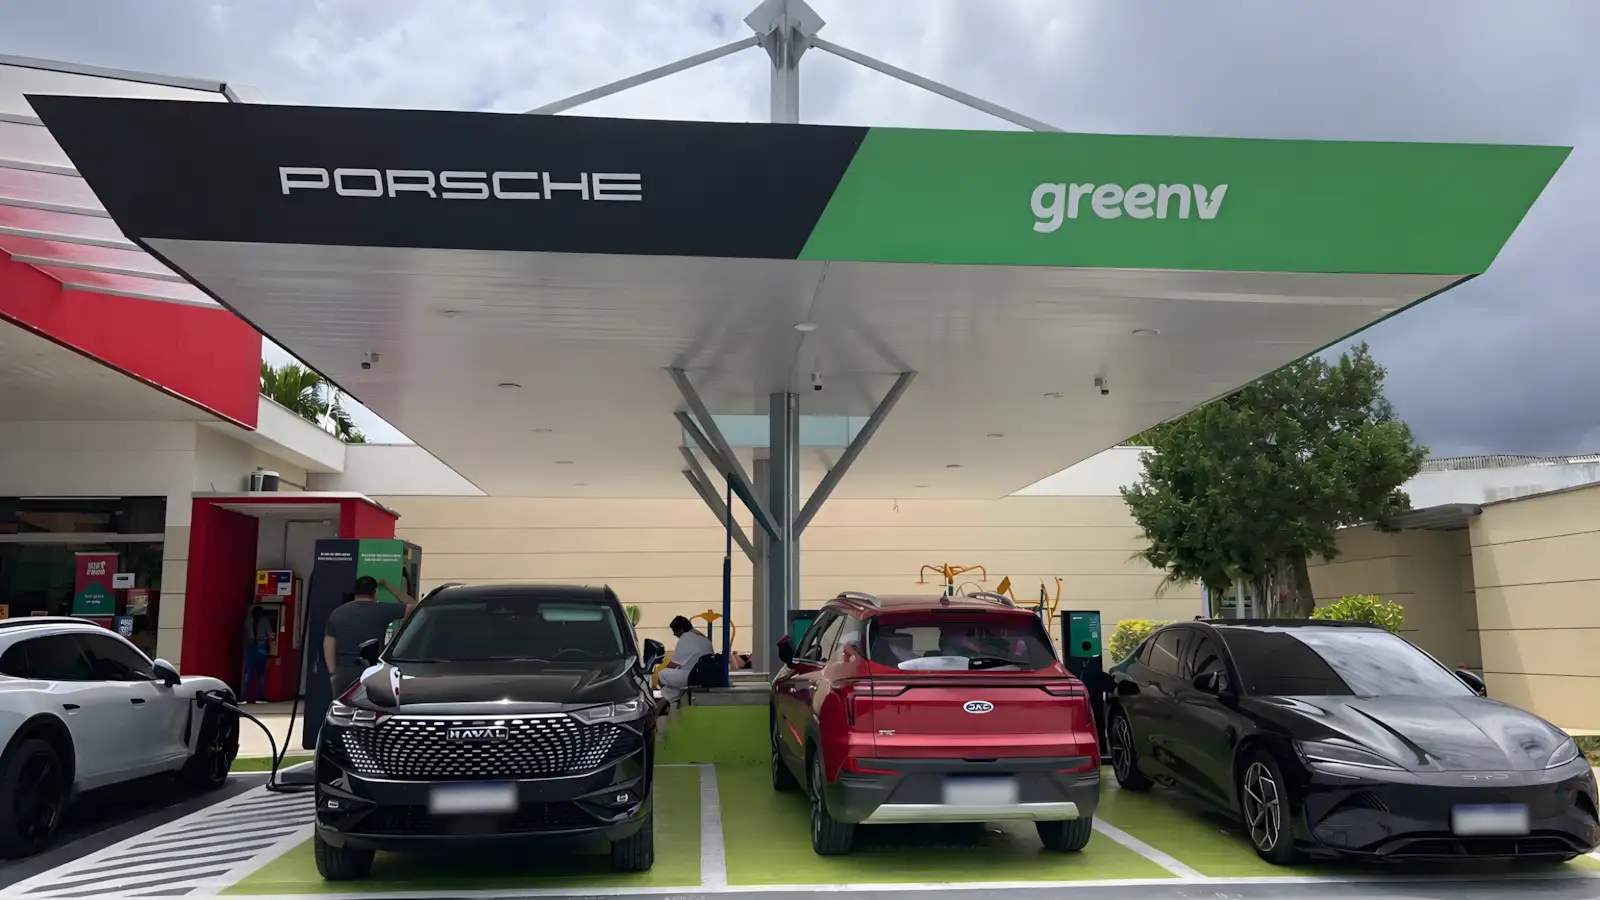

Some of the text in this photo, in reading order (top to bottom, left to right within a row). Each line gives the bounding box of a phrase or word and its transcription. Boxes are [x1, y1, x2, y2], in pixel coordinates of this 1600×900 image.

[279, 167, 642, 201] PORSCHE
[1030, 182, 1228, 233] greenv
[449, 729, 505, 738] HAVAL
